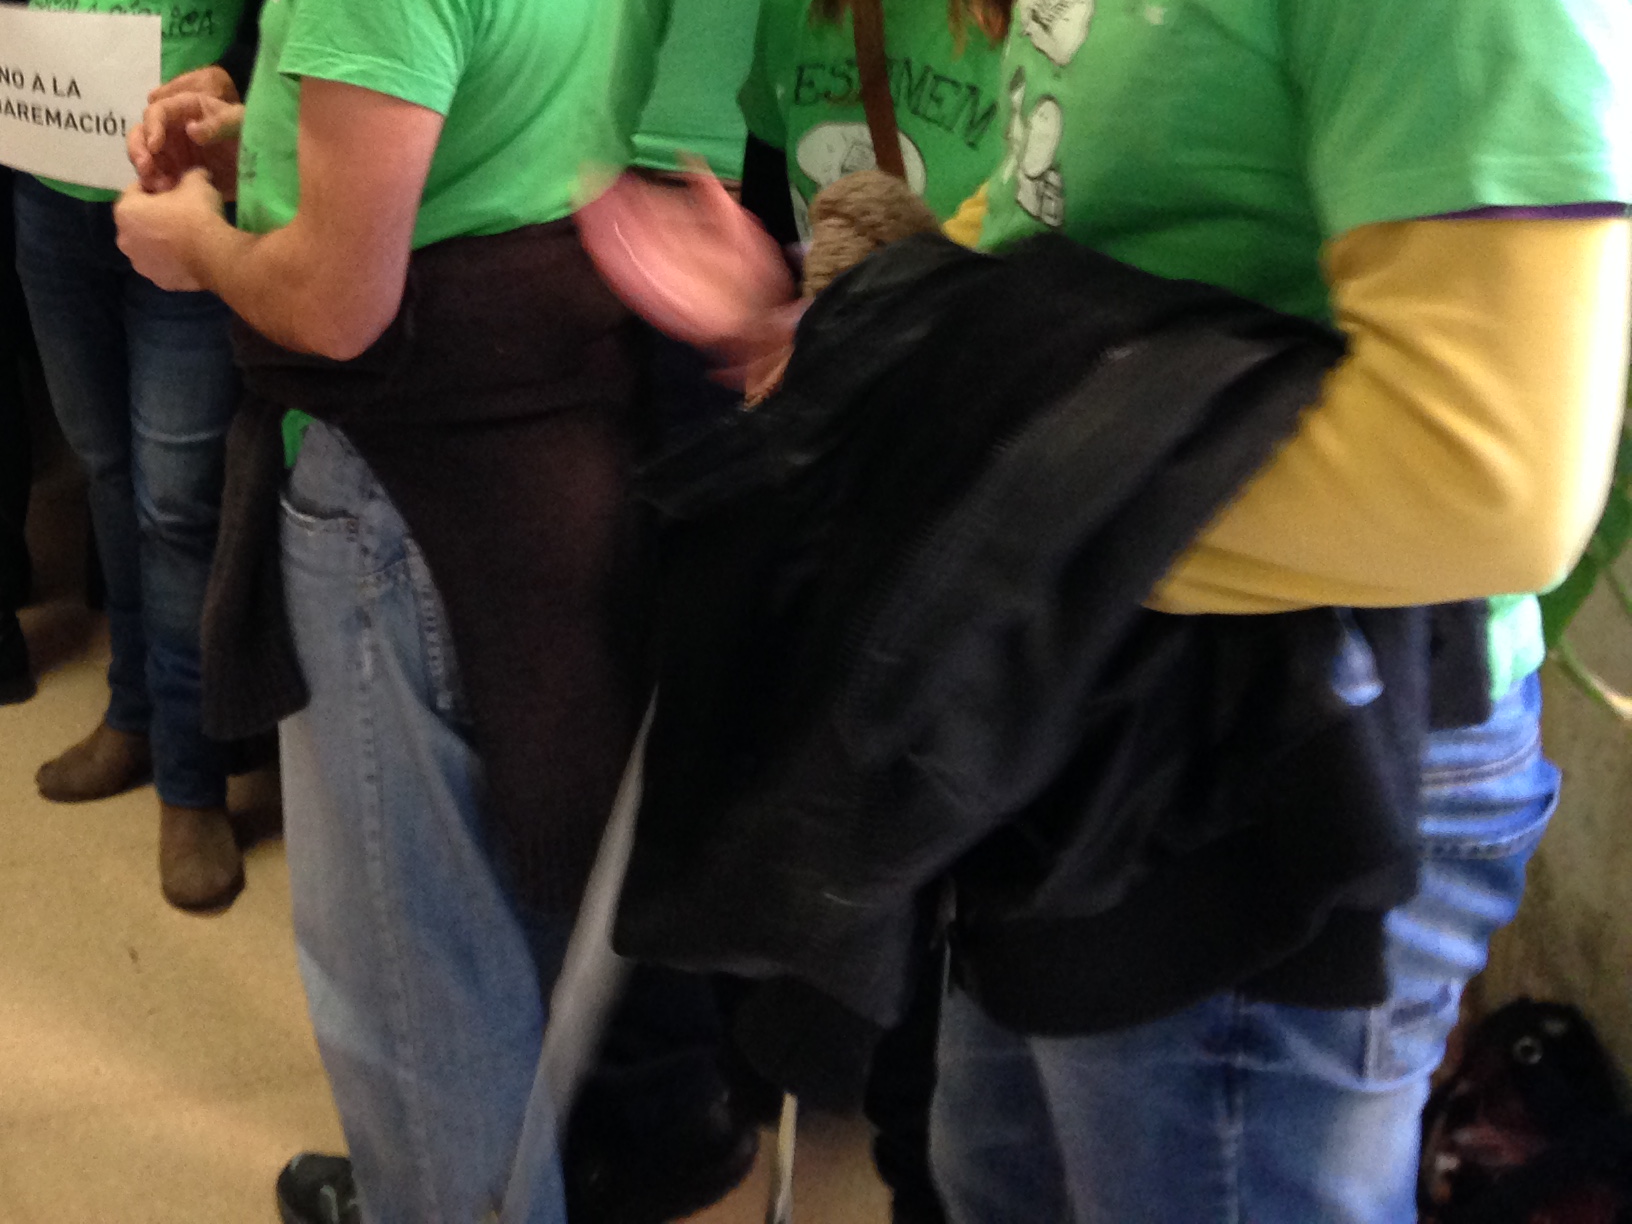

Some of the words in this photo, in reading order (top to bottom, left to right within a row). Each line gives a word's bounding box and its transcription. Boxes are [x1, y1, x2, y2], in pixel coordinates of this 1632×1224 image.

[32, 73, 46, 94] A
[52, 76, 82, 99] LA
[794, 57, 999, 150] ESMEM
